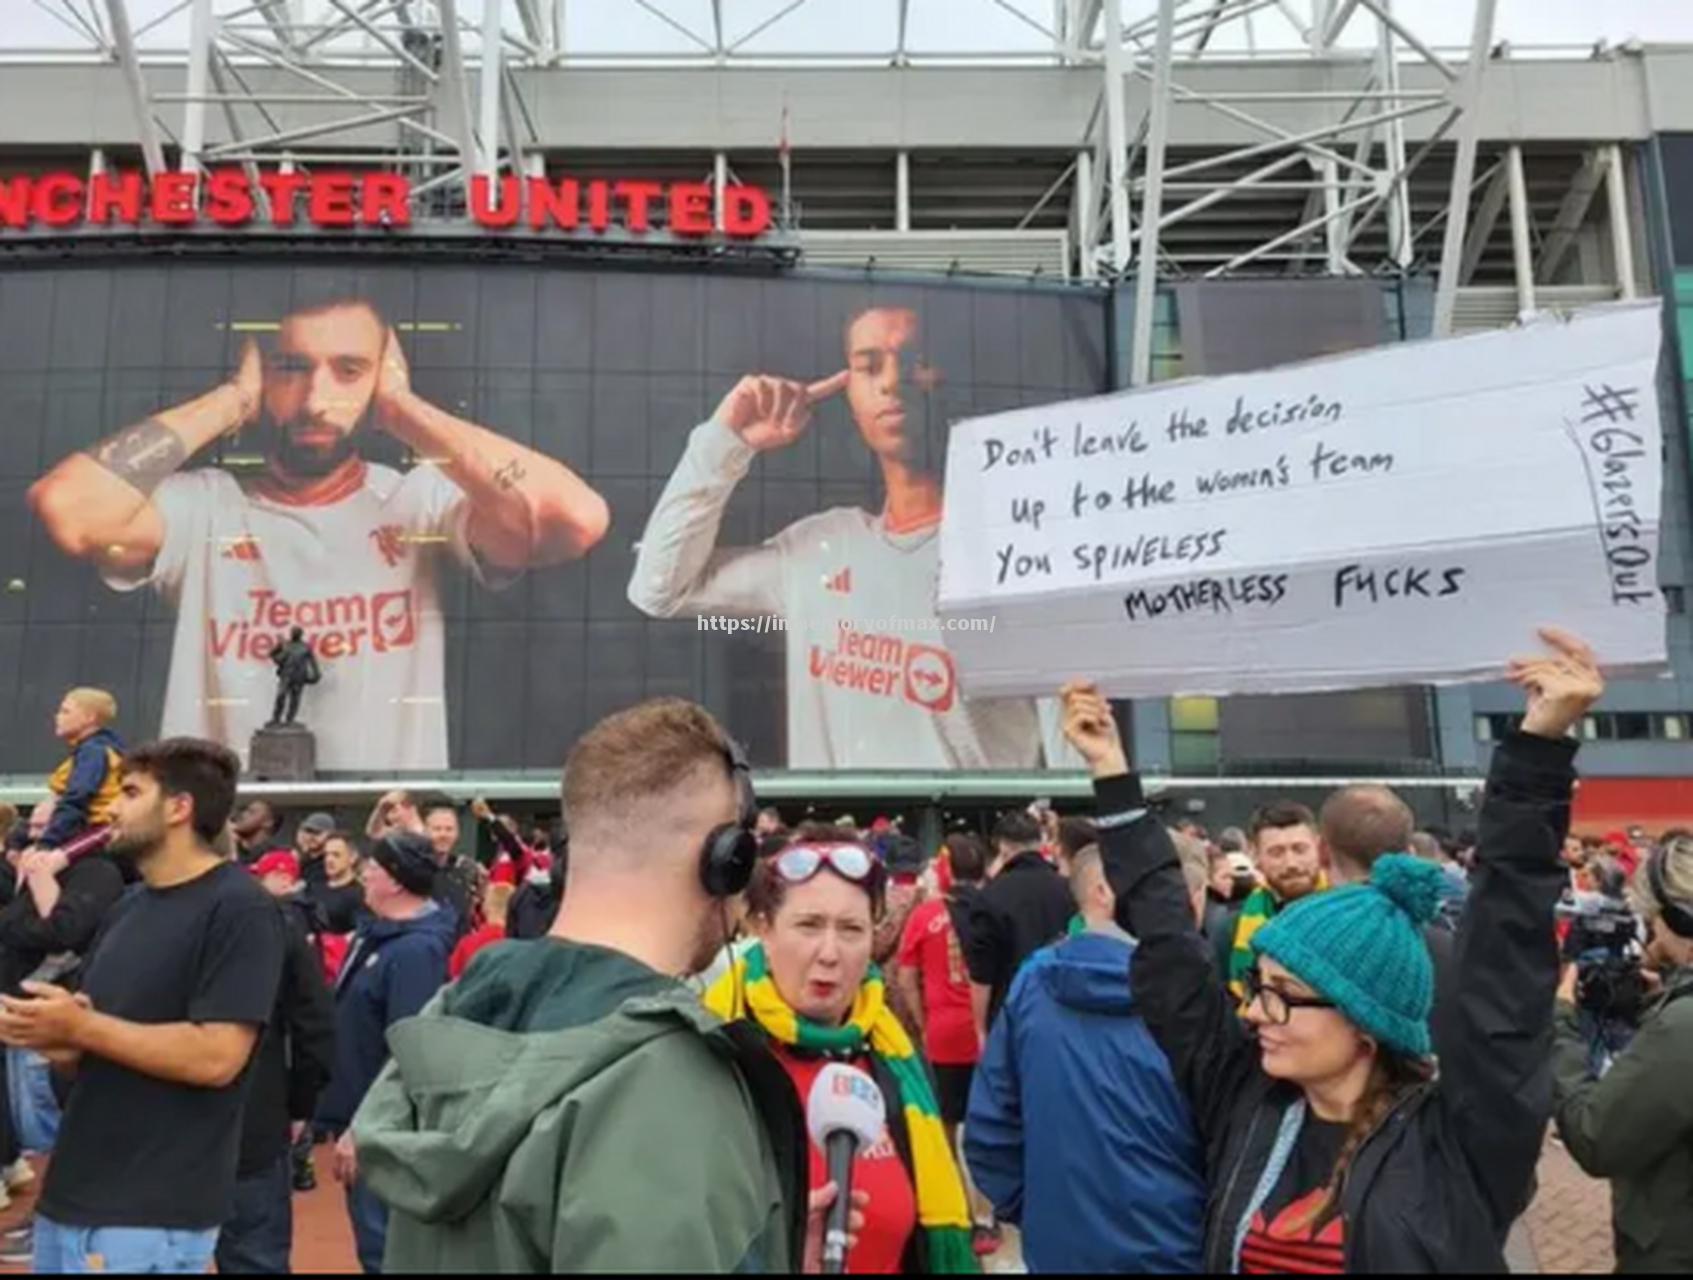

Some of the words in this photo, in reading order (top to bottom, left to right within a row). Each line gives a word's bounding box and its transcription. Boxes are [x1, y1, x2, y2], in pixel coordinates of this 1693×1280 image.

[470, 173, 770, 236] UNITED
[981, 433, 1058, 472] Don't
[1074, 422, 1148, 458] leave
[1166, 409, 1208, 442] the
[1226, 394, 1343, 434] decision
[1072, 482, 1112, 517] to
[1122, 473, 1176, 508] the
[1310, 441, 1395, 479] team
[996, 545, 1052, 585] You
[1073, 529, 1227, 579] SPINELESS
[248, 589, 367, 629] Team
[1124, 572, 1290, 621] MOTHERLESS
